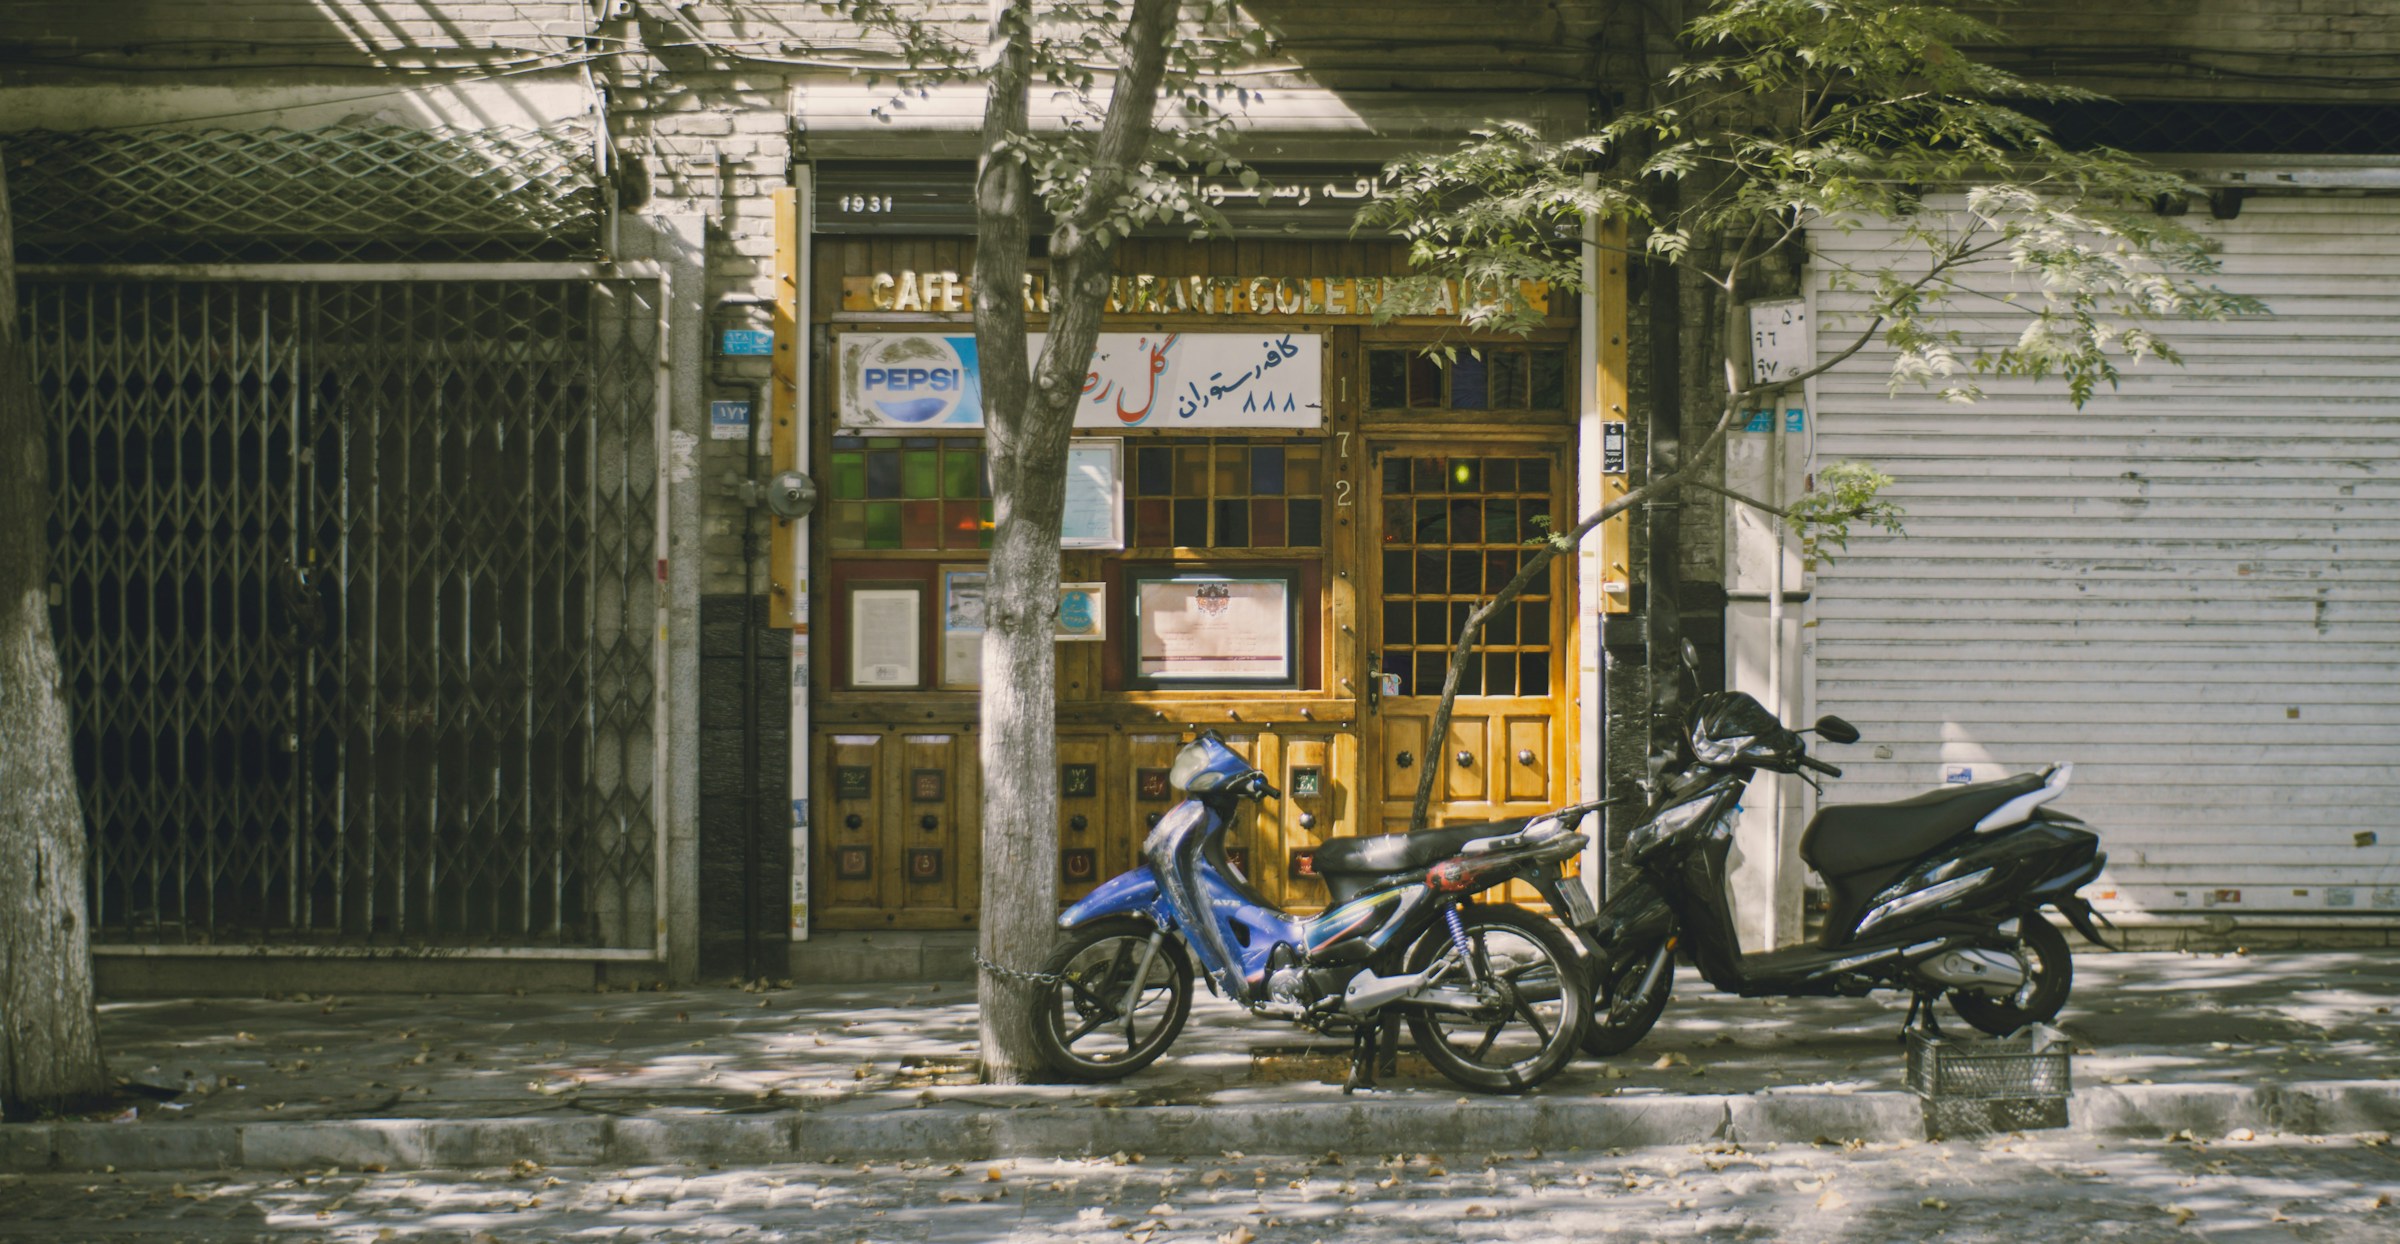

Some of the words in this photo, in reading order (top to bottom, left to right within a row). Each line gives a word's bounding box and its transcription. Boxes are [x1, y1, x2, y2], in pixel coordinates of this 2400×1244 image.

[839, 195, 893, 214] 1931
[872, 270, 964, 312] CAFE
[1249, 275, 1347, 315] GOLE
[1263, 333, 1299, 371] کافه
[864, 367, 960, 392] PEPSI
[1178, 364, 1262, 419] رستوران
[719, 406, 748, 421] ۱۷۲
[1242, 390, 1296, 414] ۸۸۸
[1213, 898, 1241, 907] AVE
